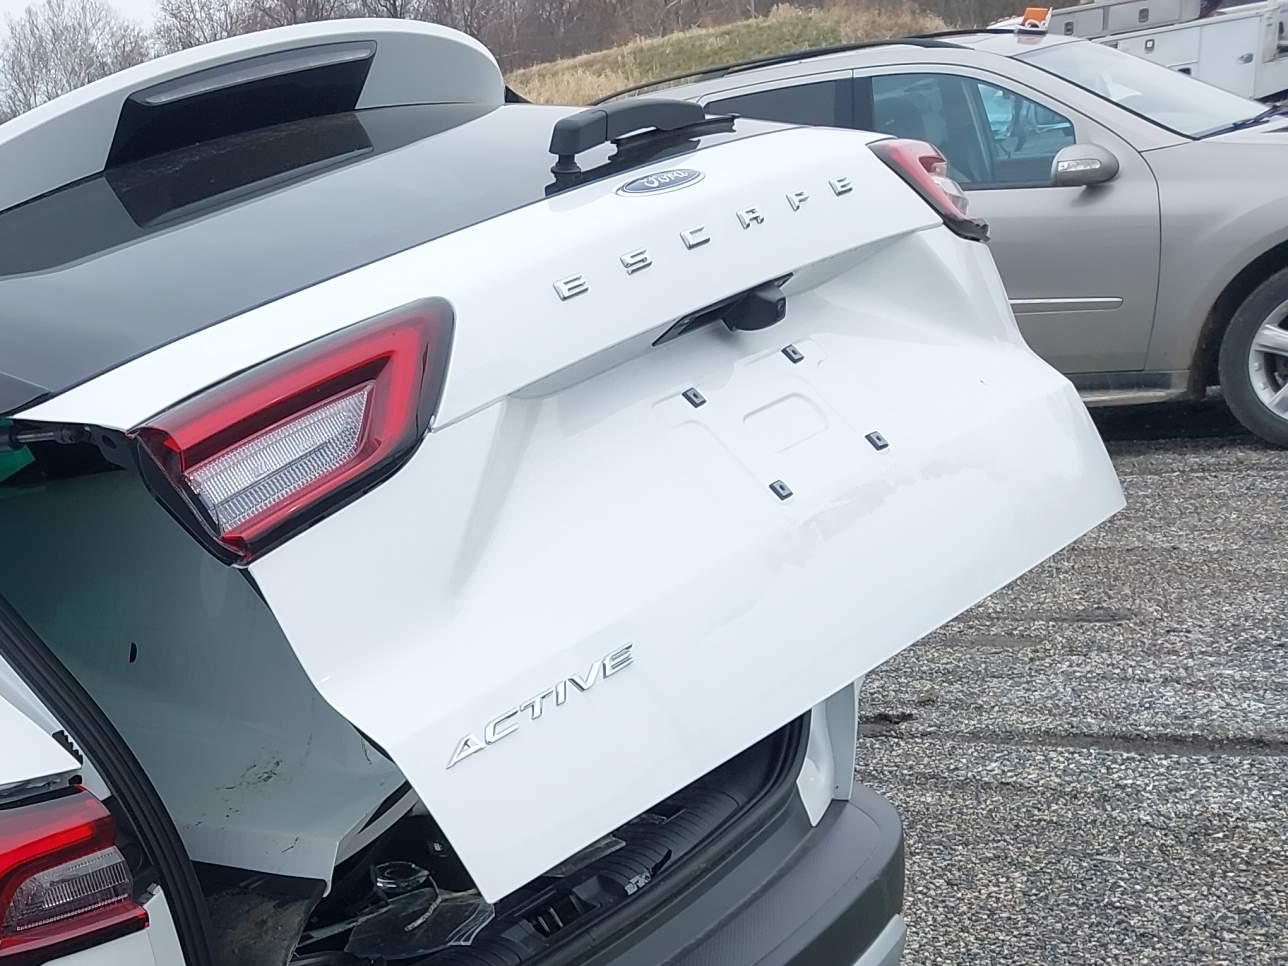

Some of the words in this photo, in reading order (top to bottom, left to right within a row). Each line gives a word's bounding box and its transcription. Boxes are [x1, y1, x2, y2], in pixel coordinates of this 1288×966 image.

[554, 177, 854, 302] ESCAPE
[642, 171, 690, 188] Ford
[445, 642, 634, 769] ACTIVE
